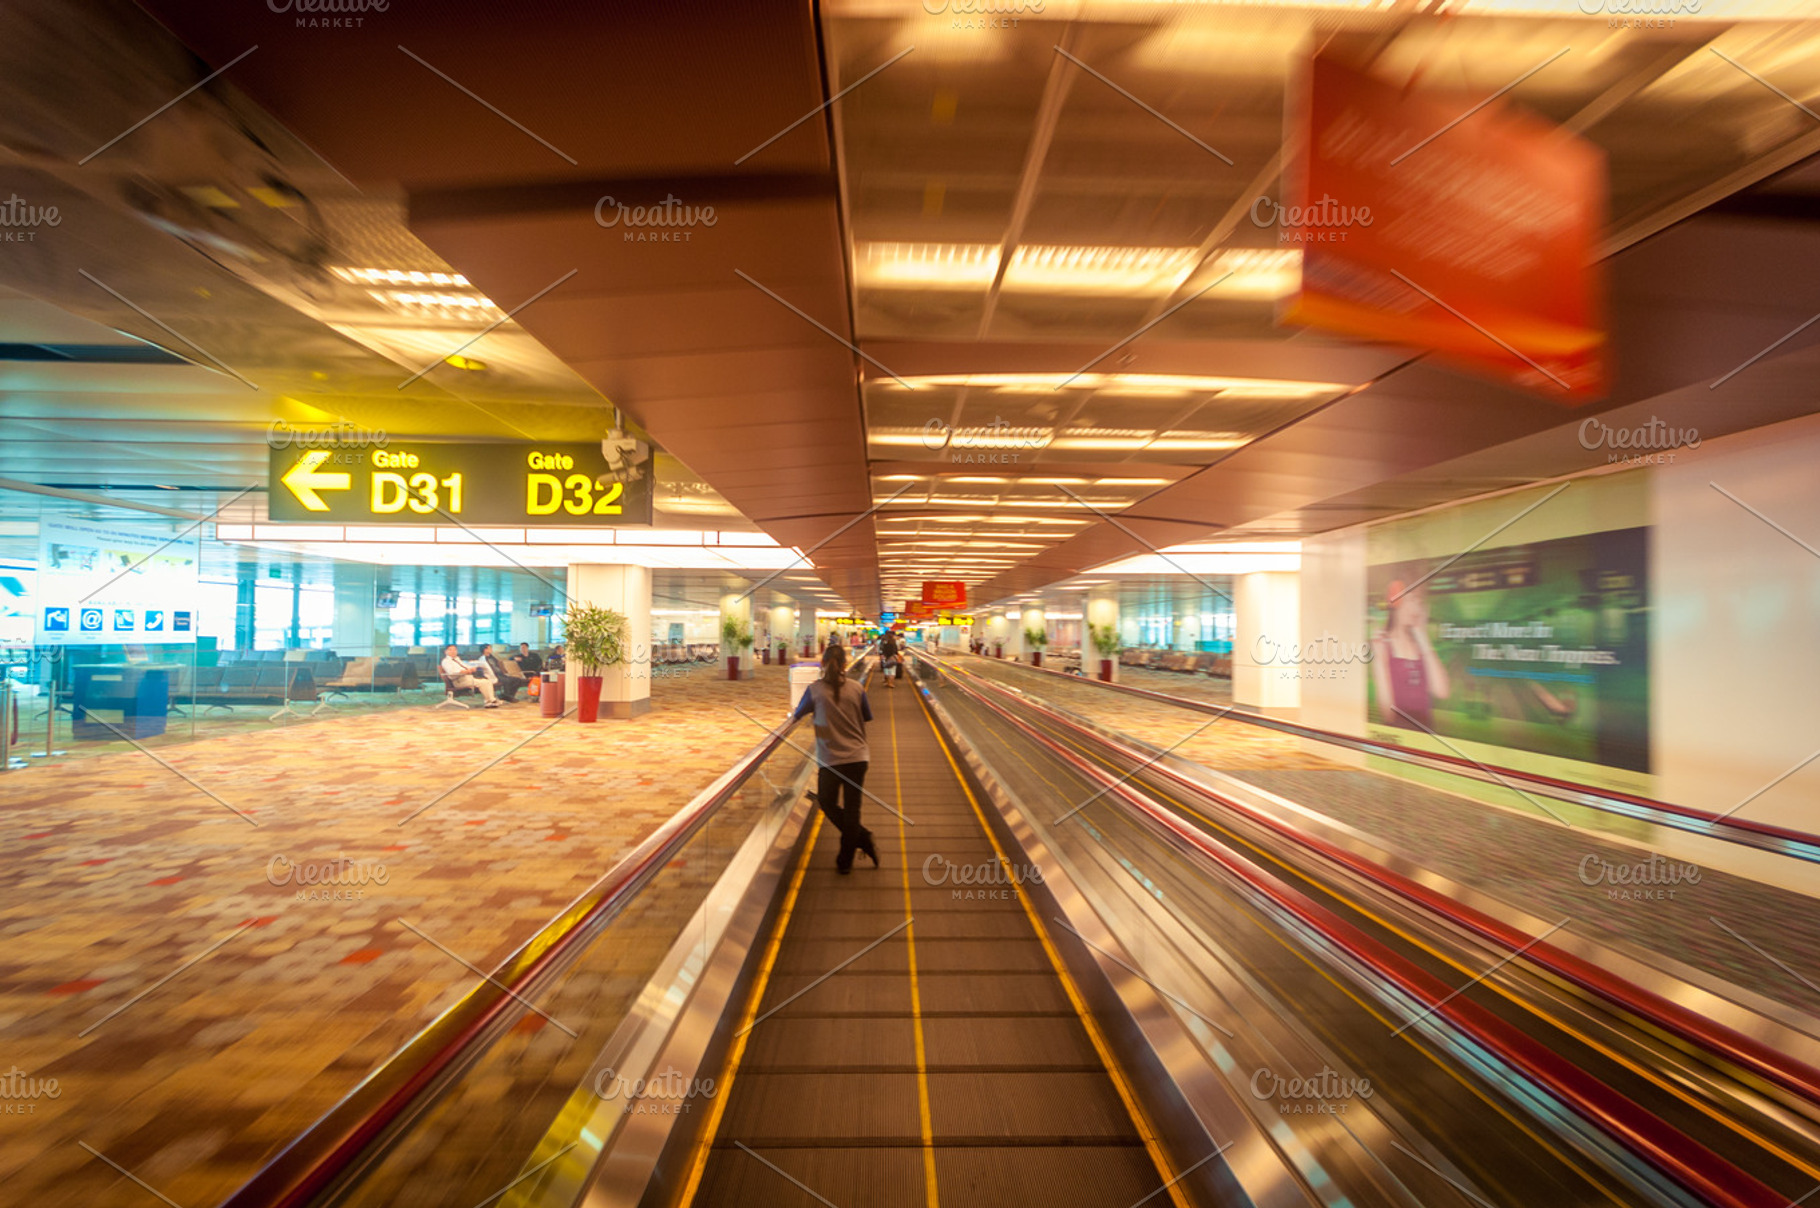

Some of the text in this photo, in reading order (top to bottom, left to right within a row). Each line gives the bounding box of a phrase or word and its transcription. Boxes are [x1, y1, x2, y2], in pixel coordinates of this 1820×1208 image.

[372, 450, 420, 468] Gate
[528, 452, 574, 470] Gate
[370, 471, 462, 514] D31
[526, 473, 623, 515] D32
